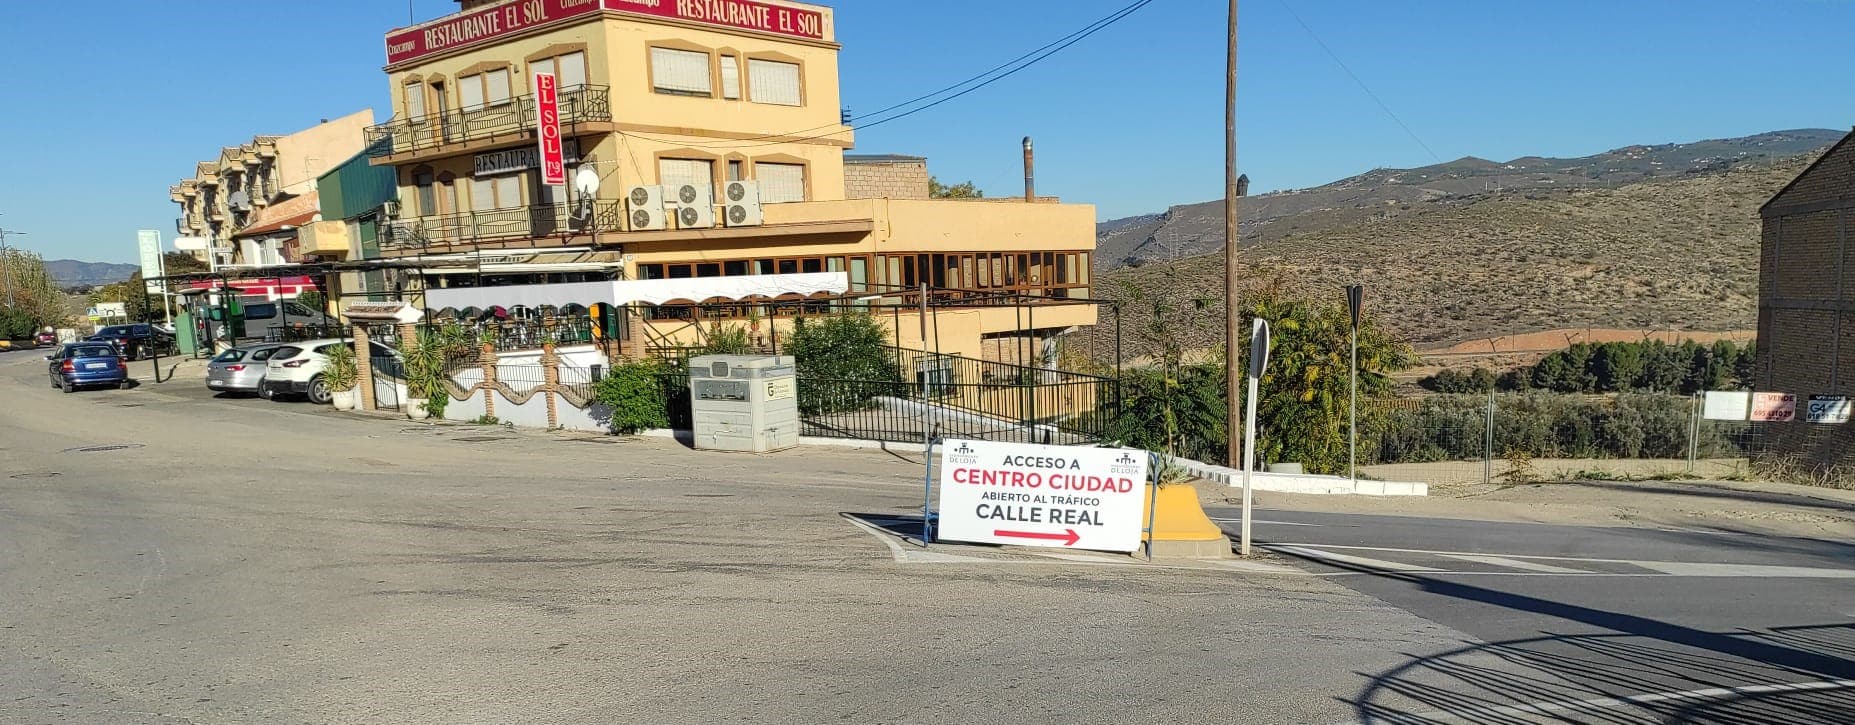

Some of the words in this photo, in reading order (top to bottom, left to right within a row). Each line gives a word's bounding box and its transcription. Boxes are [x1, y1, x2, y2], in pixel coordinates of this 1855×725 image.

[424, 10, 501, 50] RESTAURANTE
[505, 6, 522, 29] EL
[523, 0, 549, 24] SOL
[677, 0, 771, 30] RESTAURANTE
[779, 9, 795, 33] EL
[797, 12, 822, 36] SOL
[540, 74, 554, 104] EL
[543, 110, 559, 154] SOL
[1768, 394, 1794, 402] VENDE
[1002, 455, 1066, 470] ACCESO
[1070, 459, 1081, 470] A
[953, 467, 1042, 488] CENTRO
[1049, 474, 1133, 493] CIUDAD
[981, 491, 1030, 503] ABIERTO
[1033, 494, 1048, 504] AL
[1051, 494, 1100, 506] TRÁFICO
[976, 503, 1043, 523] CALLE
[1049, 508, 1104, 526] REAL
